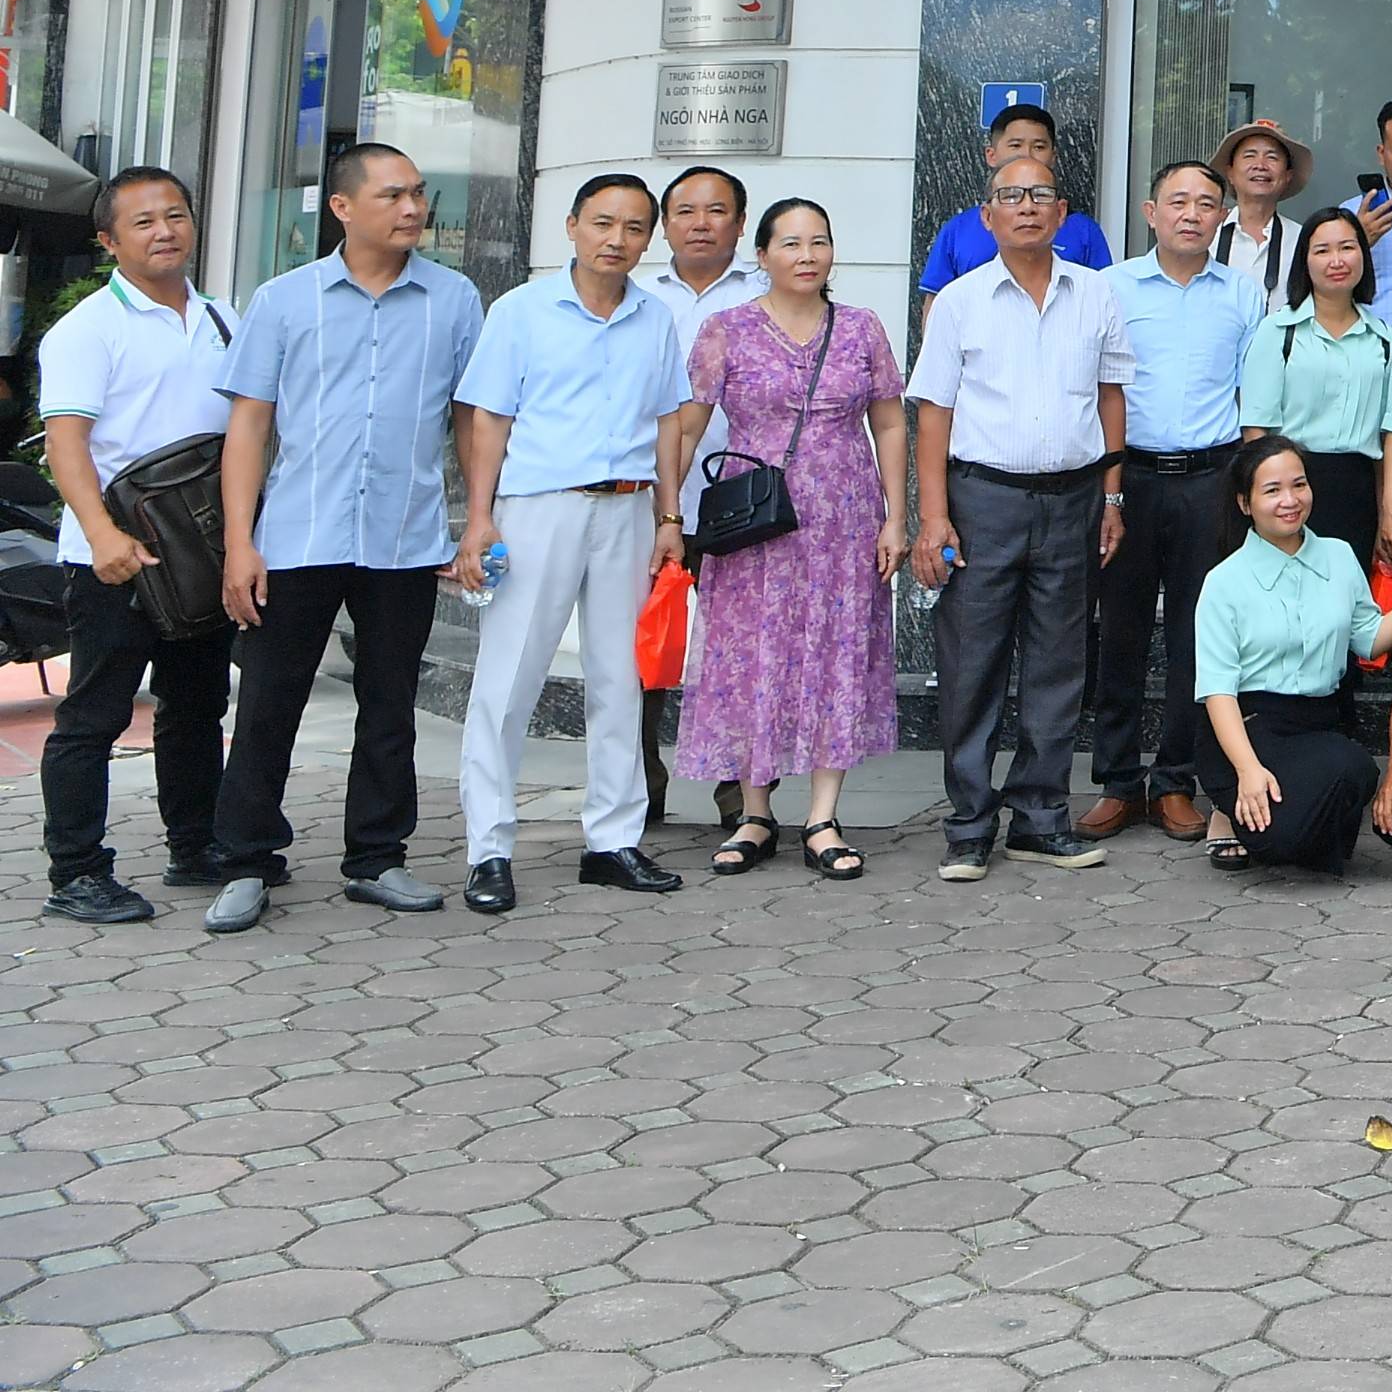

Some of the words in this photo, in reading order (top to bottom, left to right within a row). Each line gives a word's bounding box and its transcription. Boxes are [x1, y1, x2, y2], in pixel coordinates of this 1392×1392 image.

[668, 71, 696, 82] TRUNG
[697, 69, 716, 81] TÂM
[717, 70, 740, 81] GIAO
[659, 106, 693, 125] NGÔI
[697, 105, 729, 124] NHÀ
[734, 108, 769, 124] NGA
